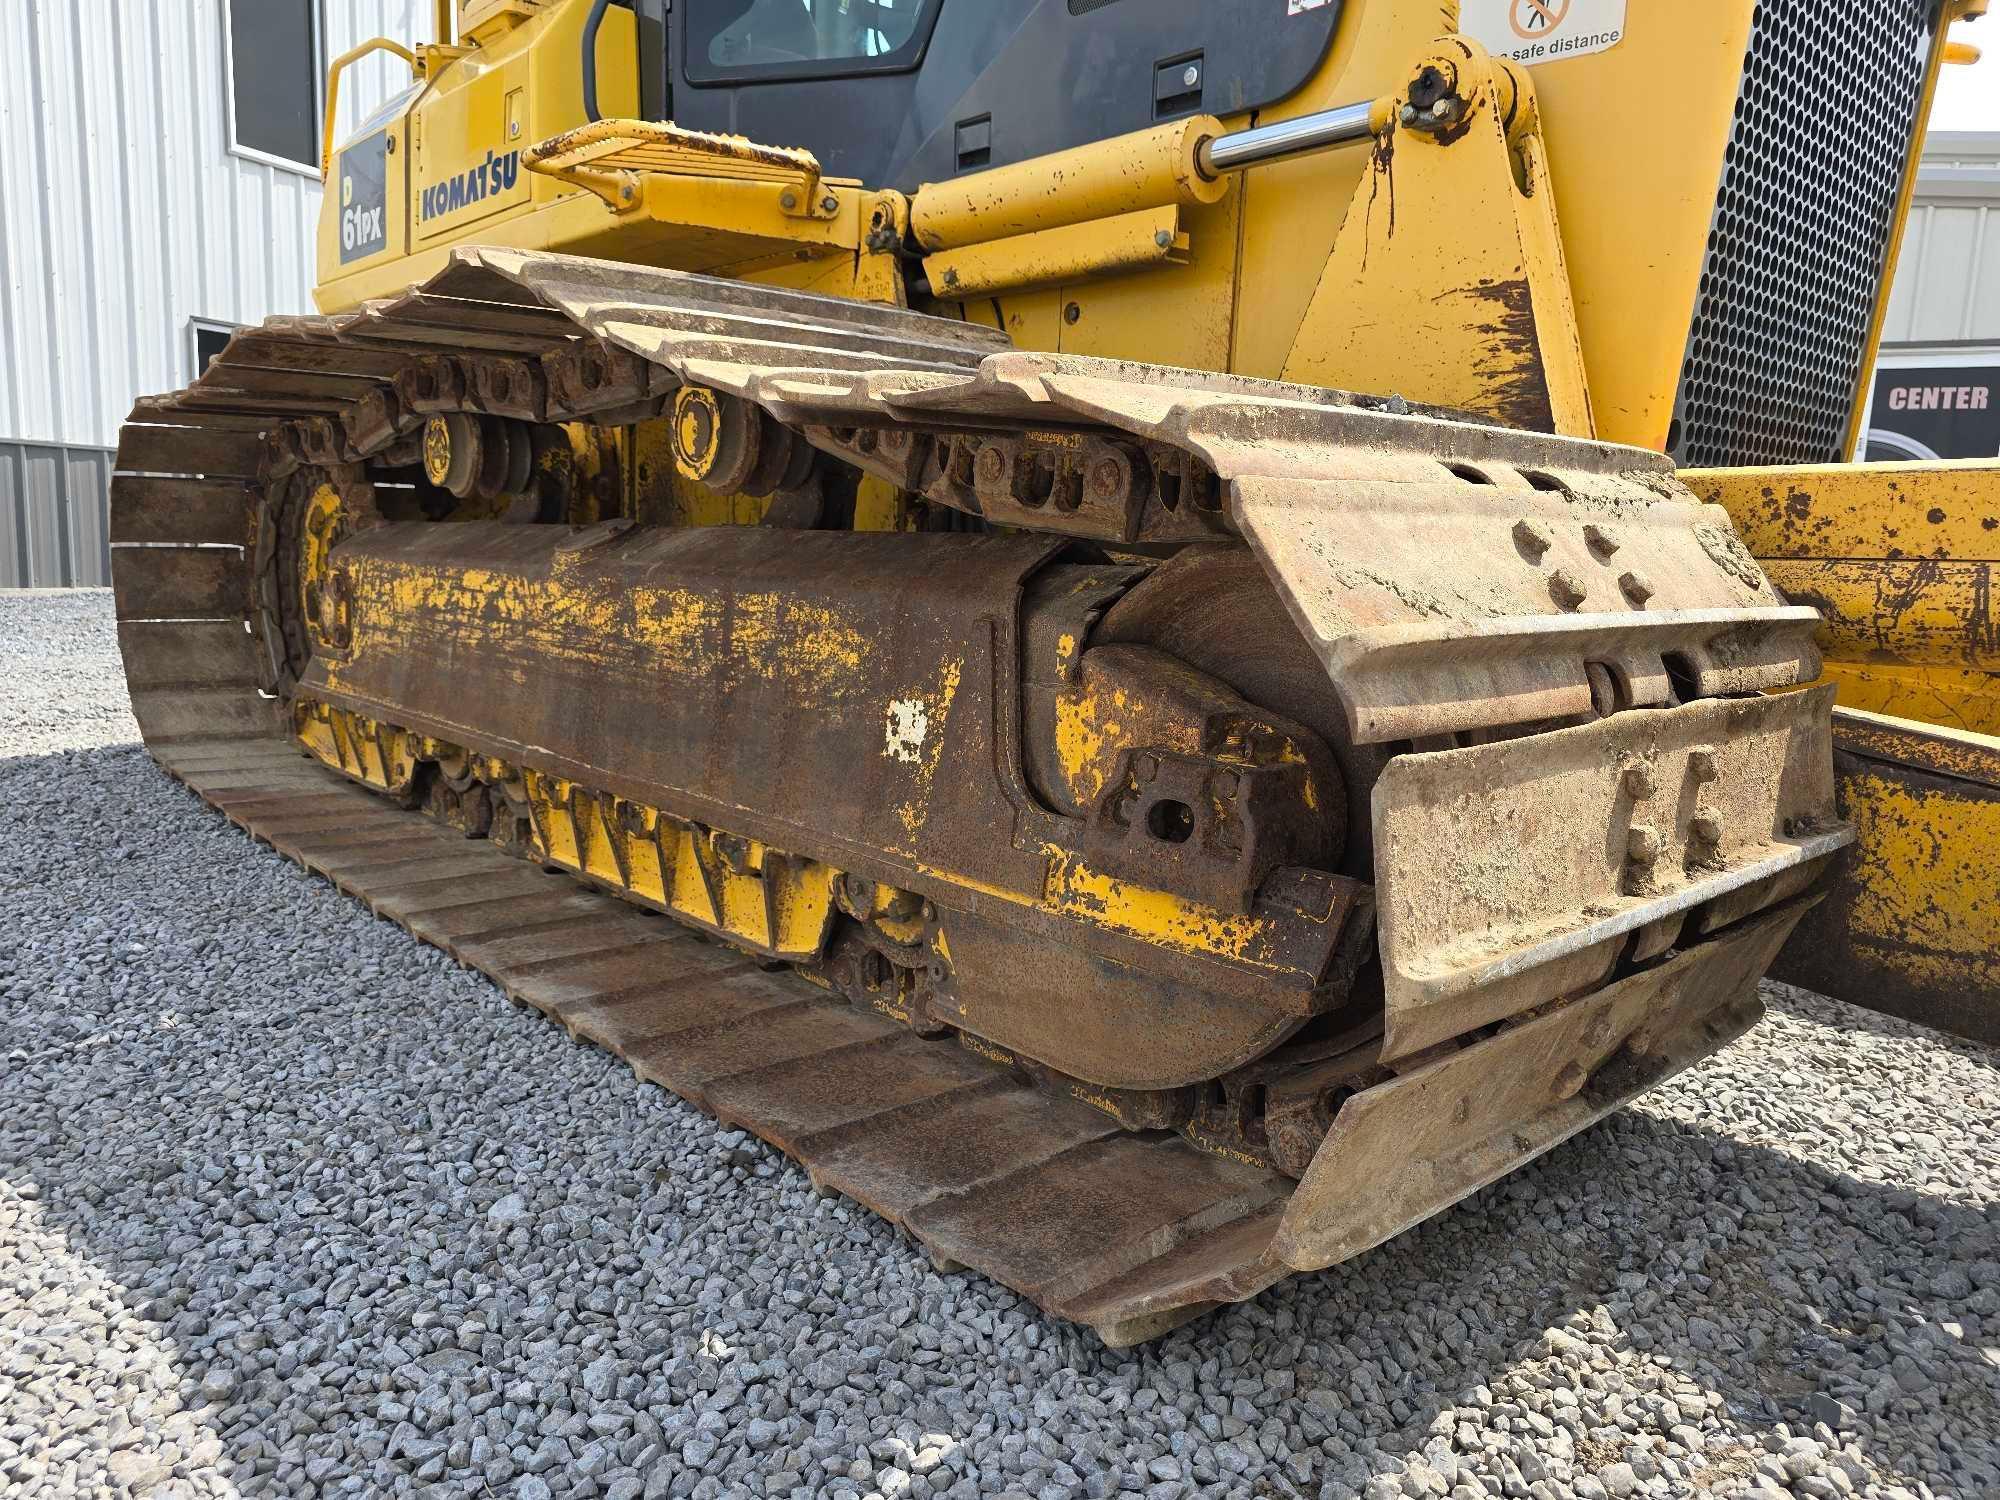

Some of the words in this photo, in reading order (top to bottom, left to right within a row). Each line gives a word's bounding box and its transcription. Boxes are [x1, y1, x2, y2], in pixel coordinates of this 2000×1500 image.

[1512, 44, 1545, 61] safe
[1549, 30, 1620, 54] distance
[343, 175, 353, 207] D
[422, 150, 519, 221] KOMATSU
[342, 204, 382, 251] 61PX
[1888, 386, 1989, 410] CENTER
